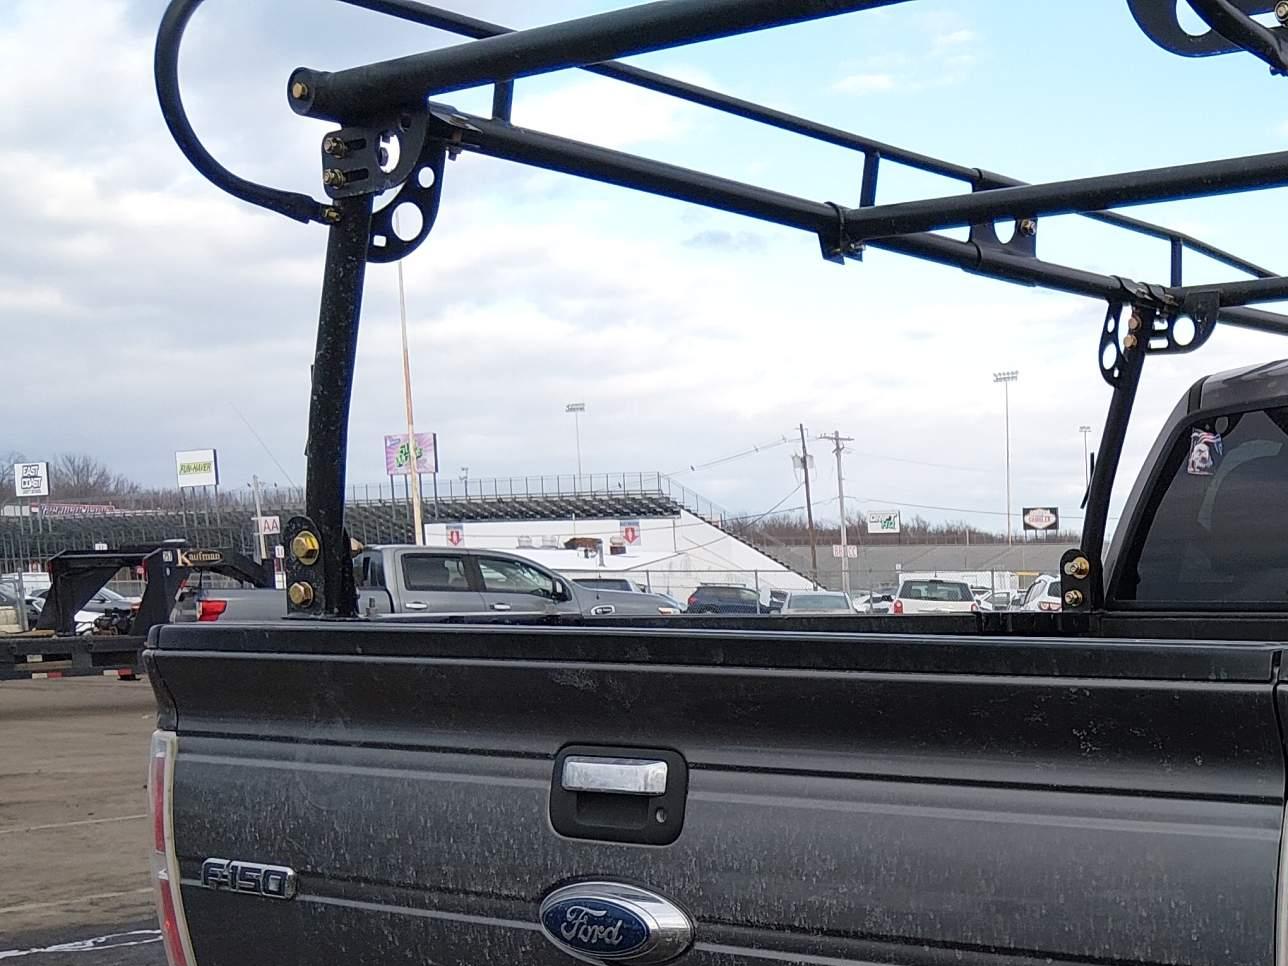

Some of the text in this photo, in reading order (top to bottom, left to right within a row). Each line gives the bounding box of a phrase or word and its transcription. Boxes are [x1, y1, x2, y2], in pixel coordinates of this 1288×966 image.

[22, 465, 40, 477] EAST
[21, 477, 42, 489] COAST
[263, 520, 280, 533] AA
[176, 548, 221, 567] Kaufman
[560, 905, 624, 946] Ford
